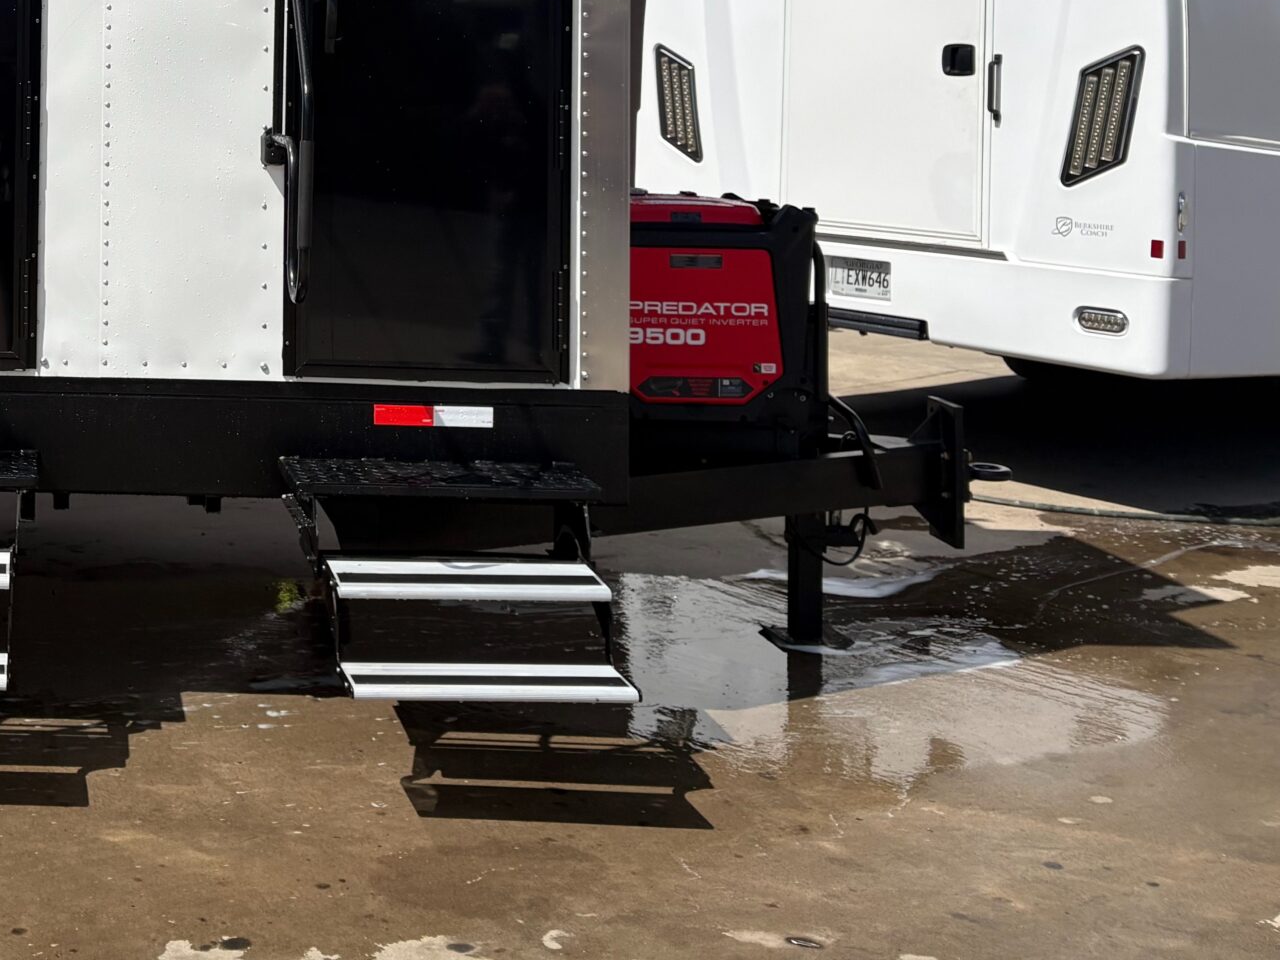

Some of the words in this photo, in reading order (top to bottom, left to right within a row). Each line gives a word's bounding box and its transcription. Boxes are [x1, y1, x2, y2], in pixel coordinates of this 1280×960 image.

[847, 268, 889, 289] EXW646
[670, 317, 706, 325] QUIET
[709, 318, 769, 327] INVERTER
